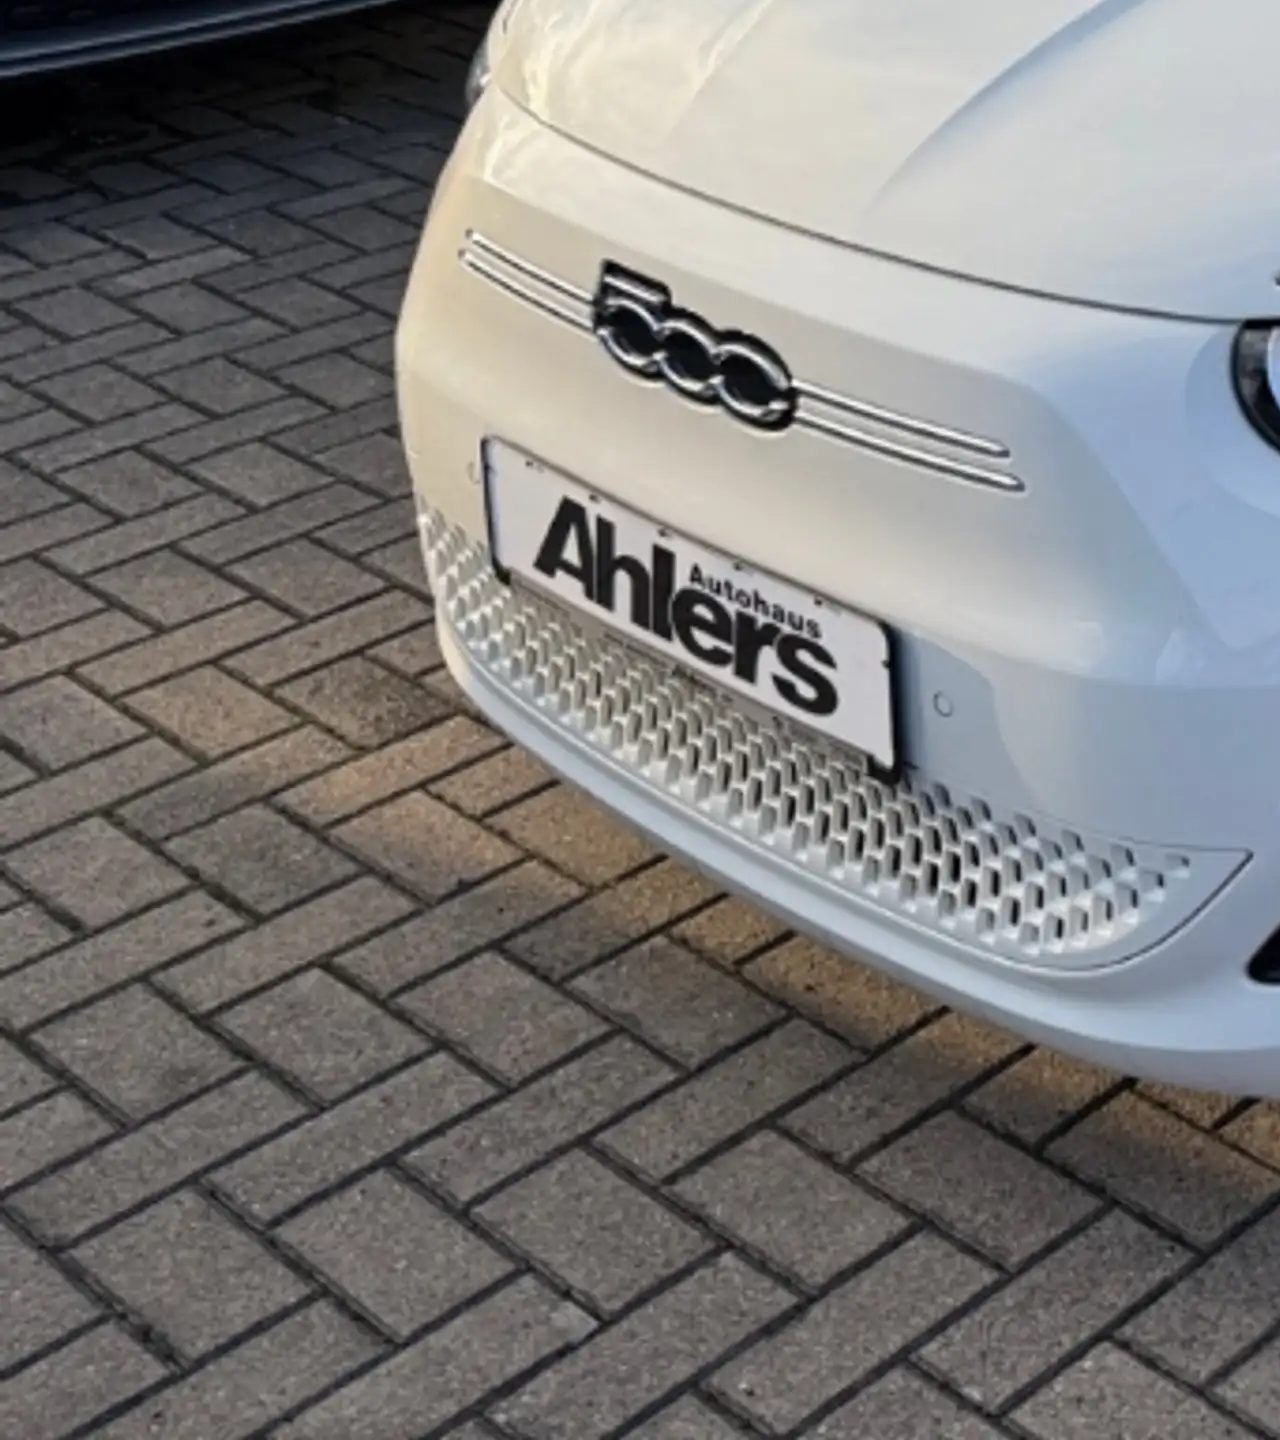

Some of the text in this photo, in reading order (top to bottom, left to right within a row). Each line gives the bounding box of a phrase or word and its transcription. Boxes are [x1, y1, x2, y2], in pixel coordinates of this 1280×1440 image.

[594, 260, 799, 431] 500
[533, 495, 838, 716] Ahlers
[688, 563, 823, 638] Autohaus
